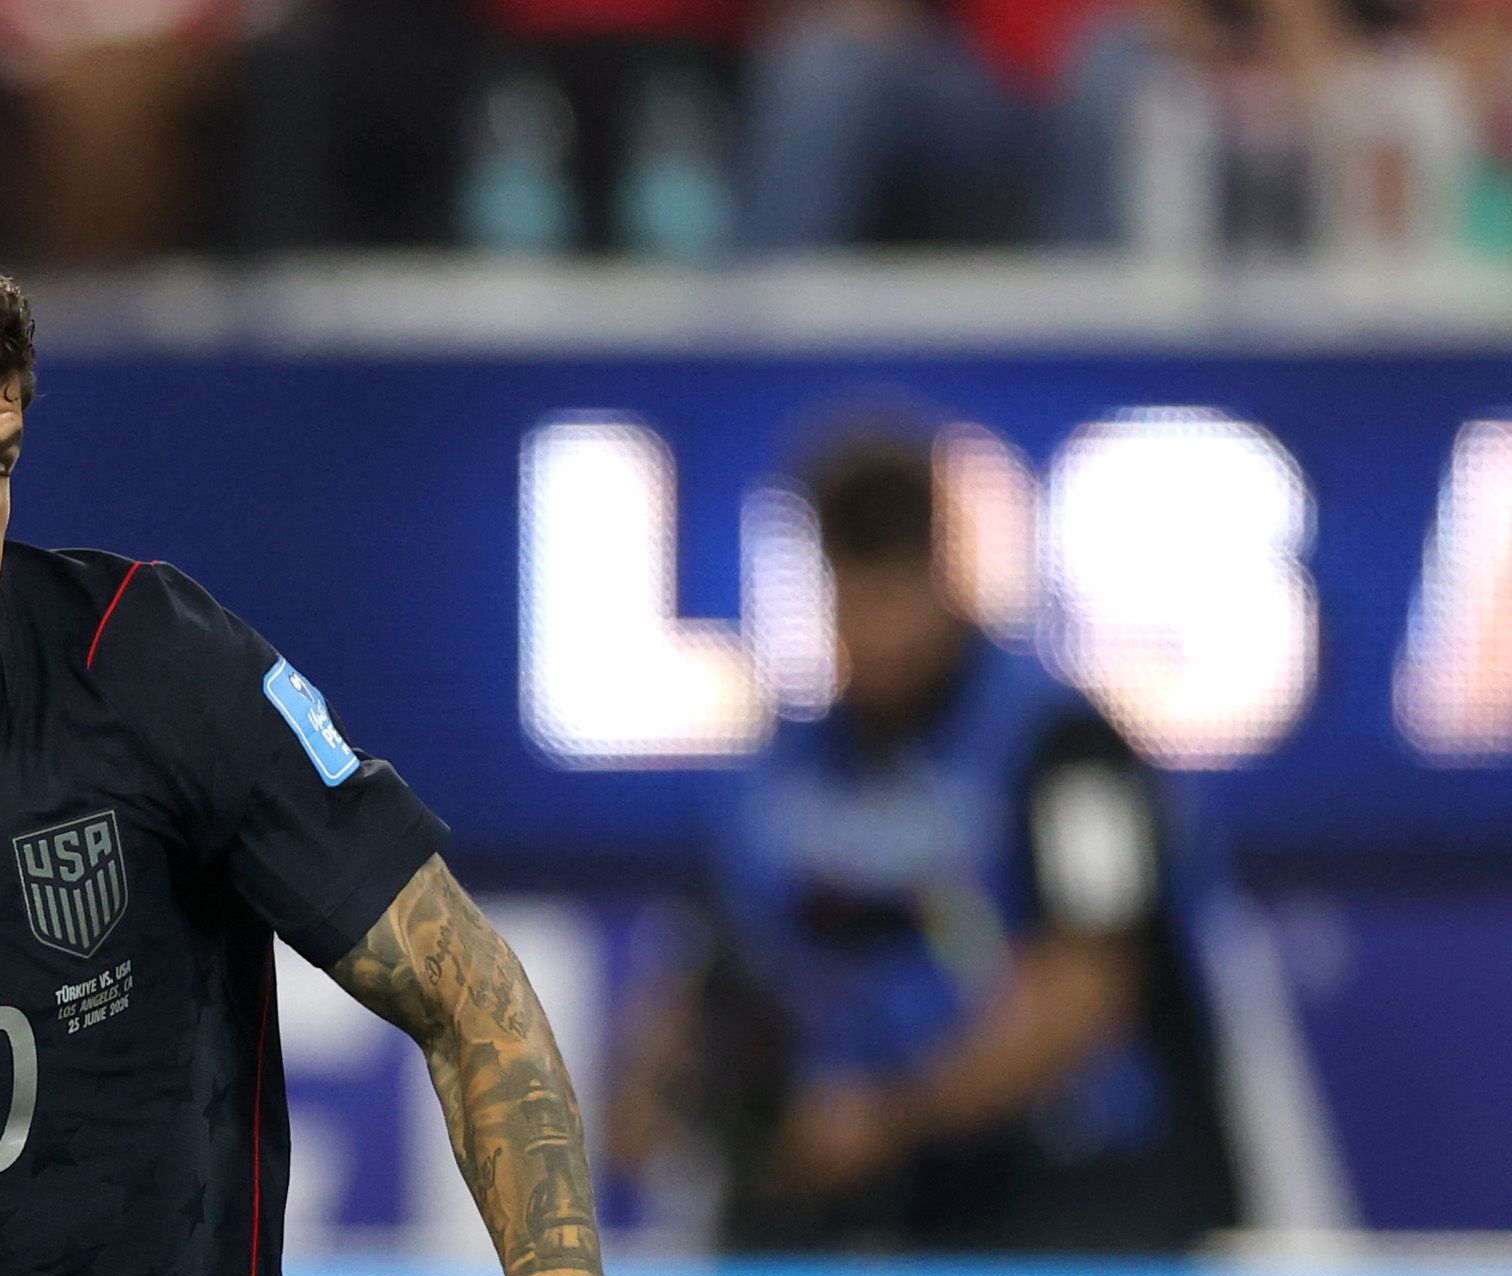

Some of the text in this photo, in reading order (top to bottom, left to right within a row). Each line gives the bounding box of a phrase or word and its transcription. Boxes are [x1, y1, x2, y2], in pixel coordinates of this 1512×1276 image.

[23, 821, 113, 882] USA
[99, 970, 114, 989] VS.
[116, 960, 132, 980] USA
[58, 1003, 77, 1020] LOS
[68, 1017, 80, 1034] 25
[83, 1006, 107, 1028] JUNE
